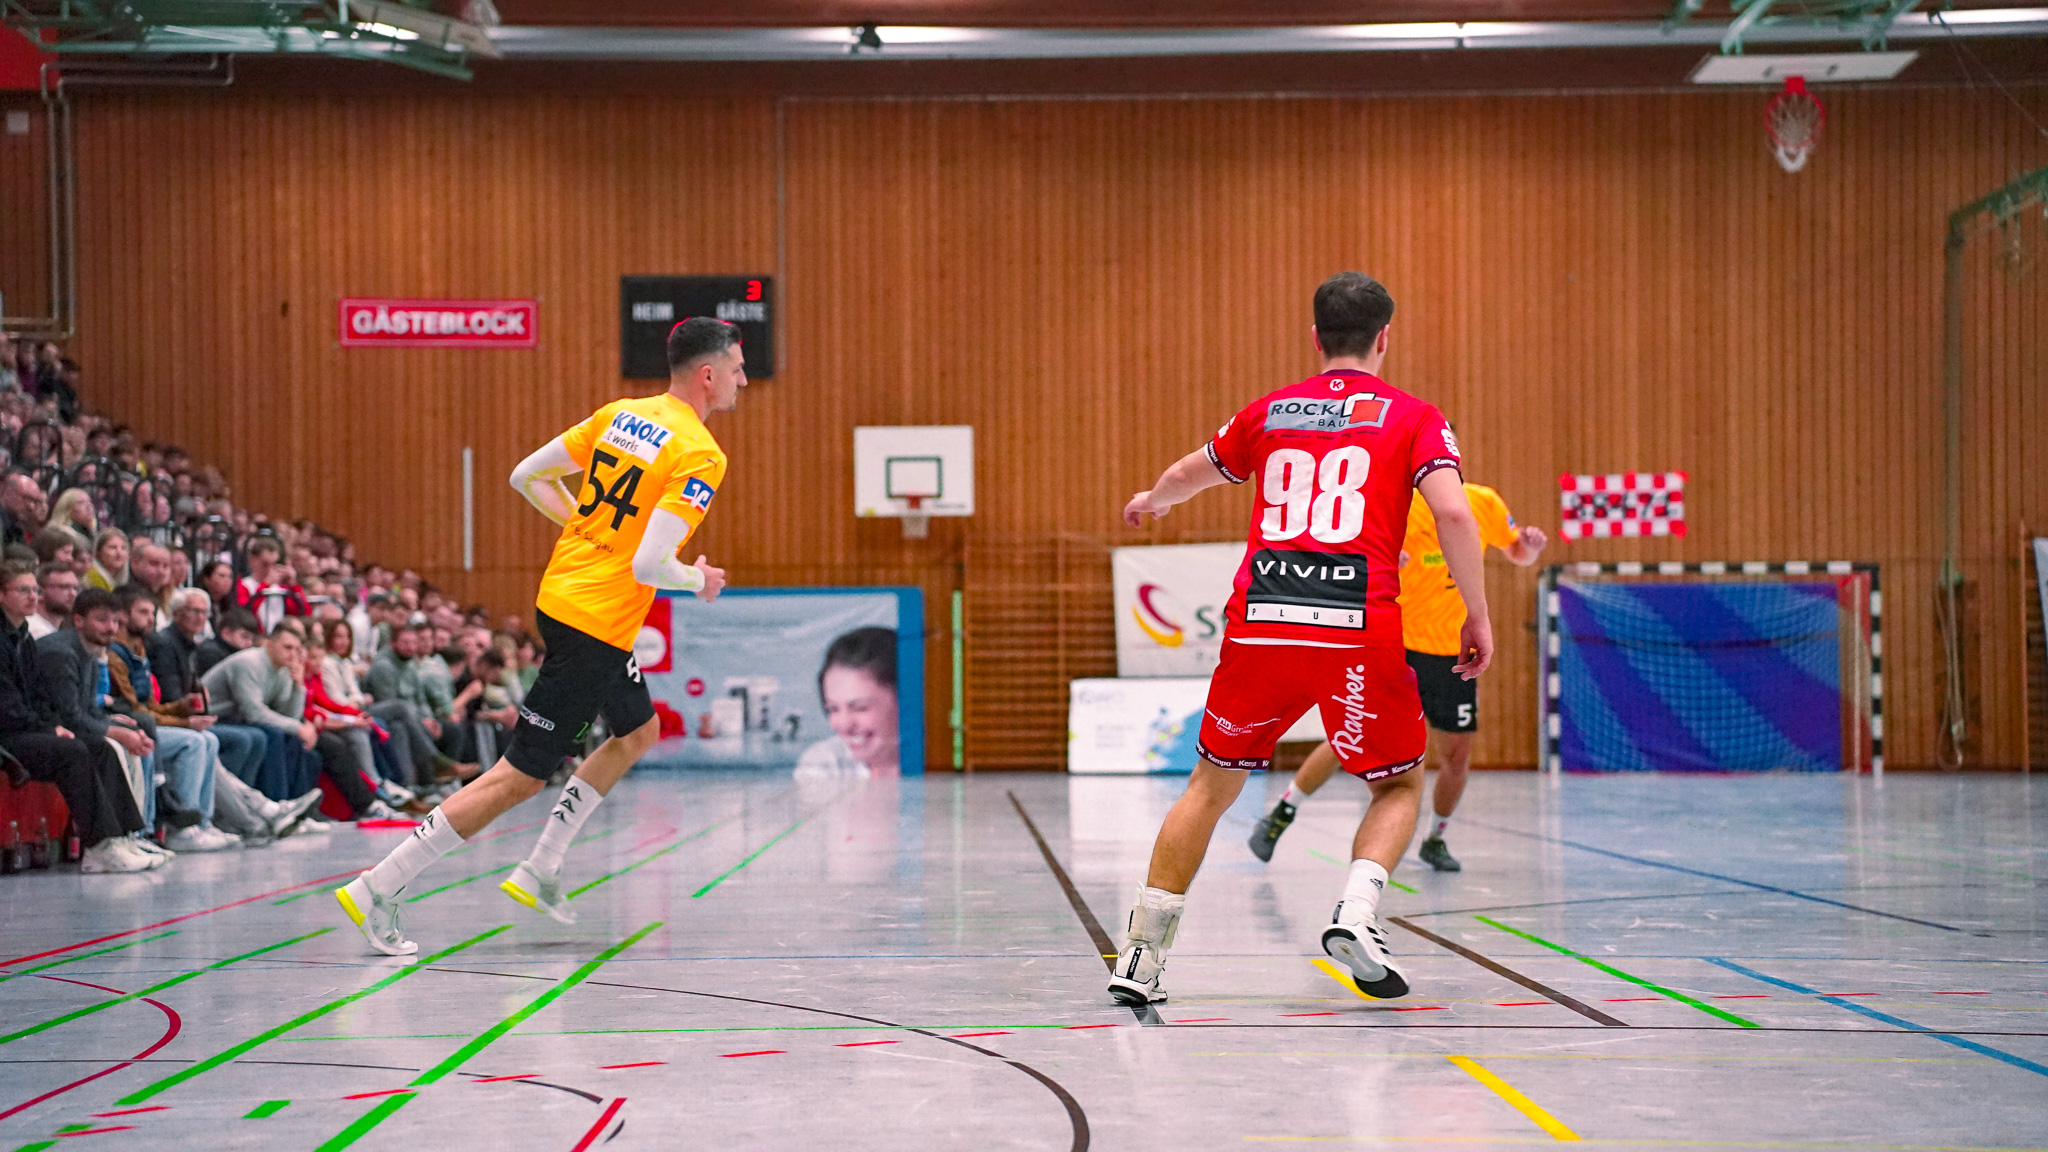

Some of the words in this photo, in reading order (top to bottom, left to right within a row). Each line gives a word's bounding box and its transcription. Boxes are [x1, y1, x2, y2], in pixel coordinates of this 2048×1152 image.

[746, 280, 762, 301] 3
[352, 304, 526, 335] GÄSTEBLOCK
[1271, 402, 1339, 416] R.O.C.K.
[612, 412, 668, 449] KNOLL
[577, 448, 645, 531] 54
[1260, 445, 1371, 544] 98
[1256, 560, 1356, 581] VIVID
[1457, 703, 1472, 727] 5
[1207, 752, 1232, 767] Kempa
